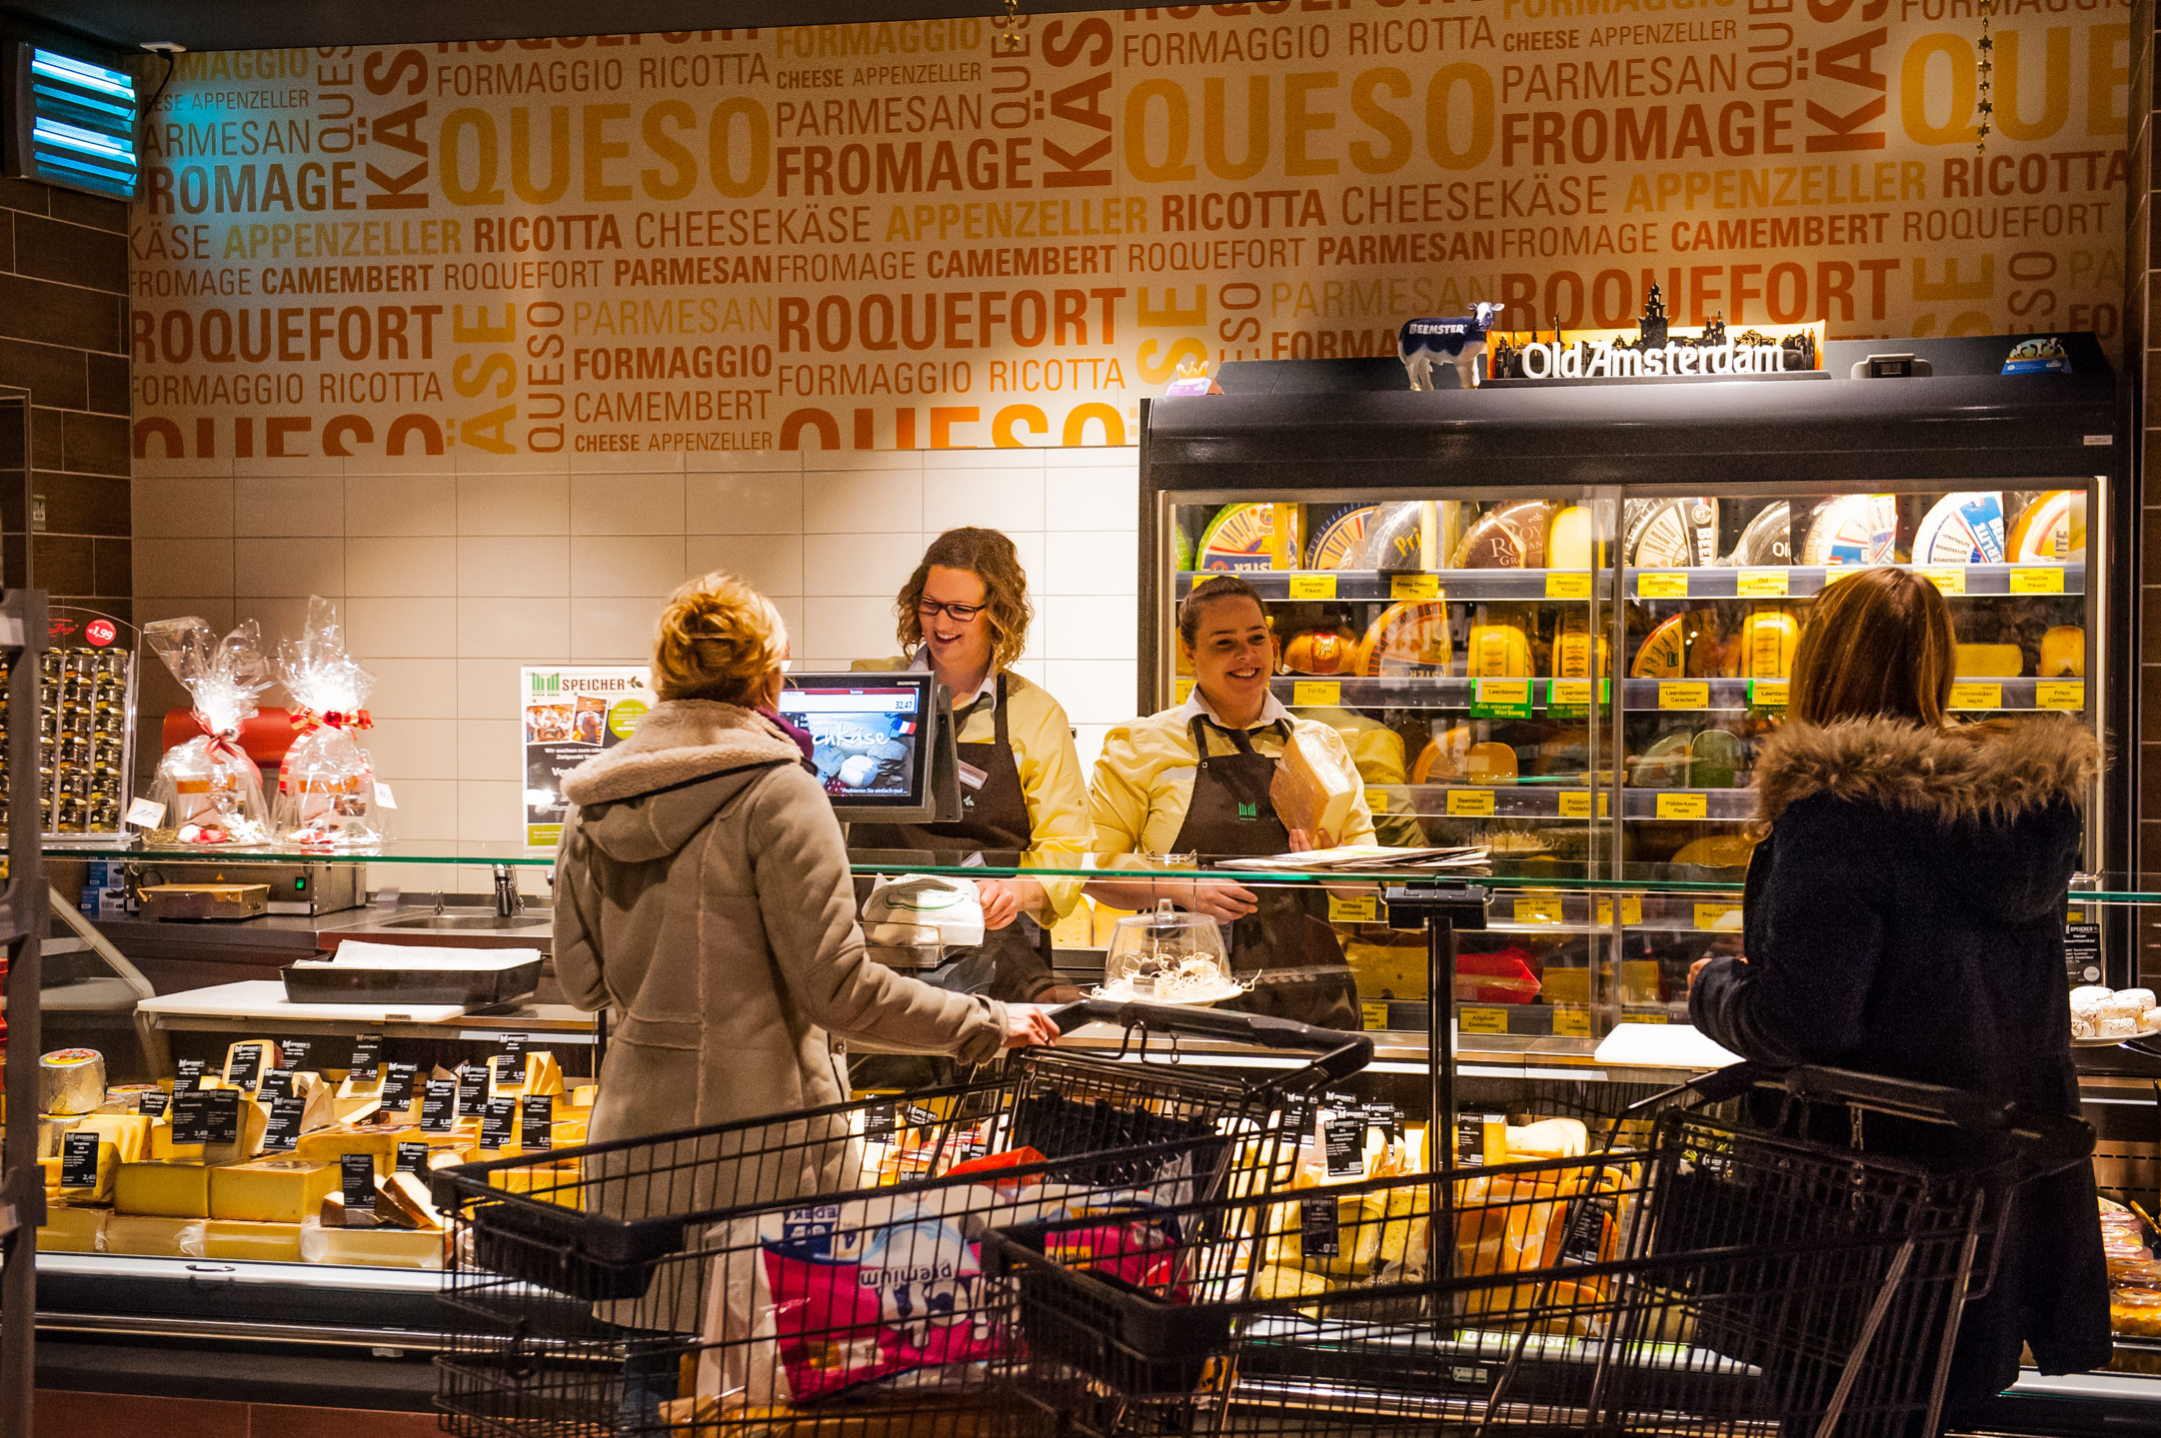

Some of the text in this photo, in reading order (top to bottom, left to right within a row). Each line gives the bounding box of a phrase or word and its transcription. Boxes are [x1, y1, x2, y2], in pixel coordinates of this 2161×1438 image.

[776, 16, 983, 60] FORMAGGIO
[1123, 15, 1496, 68] FORMAGGIO RICOTTA
[1503, 20, 1737, 53] CHEESE APPENZELLER
[437, 52, 771, 97] FORMAGGIO RICOTTA
[776, 61, 983, 90] CHEESE APPENZELLER
[1502, 52, 1737, 103] PARMESAN
[192, 88, 310, 111] APPENZELLER
[776, 93, 983, 138] PARMESAN
[1123, 62, 1496, 184] QUESO
[1502, 99, 1794, 167] FROMAGE
[439, 96, 771, 208] QUESO
[776, 137, 1034, 197] FROMAGE
[1623, 149, 2127, 213] APPENZELLER RICOTTA
[223, 218, 461, 260] APPENZELLER
[474, 213, 622, 253] RICOTTA
[885, 196, 1148, 243] APPENZELLER
[1162, 189, 1327, 232] RICOTTA
[1502, 202, 2111, 258] FROMAGE CAMEMBERT ROQUEFORT
[261, 263, 434, 295] CAMEMBERT
[444, 259, 603, 292] ROQUEFORT
[614, 254, 772, 287] PARMESAN
[777, 229, 1494, 283] FROMAGE CAMEMBERT ROQUEFORT PARMESAN
[573, 298, 772, 336] PARMESAN
[1271, 275, 1494, 319] PARMESAN
[1502, 258, 1900, 332] ROQUEFORT
[132, 304, 443, 364] ROQUEFORT
[778, 287, 1126, 353] ROQUEFORT
[1409, 323, 1465, 335] BEEMSTER
[526, 301, 565, 453] QUESO
[574, 344, 772, 381] FORMAGGIO
[778, 357, 1127, 397] FORMAGGIO RICOTTA
[1523, 340, 1786, 379] Old Amsterdam
[320, 371, 444, 404] RICOTTA
[574, 389, 772, 424] CAMEMBERT
[575, 431, 773, 452] CHEESE APPENZELLER
[562, 678, 626, 692] SPEICHER
[1494, 709, 1526, 718] Werbung
[860, 1260, 955, 1291] premium
